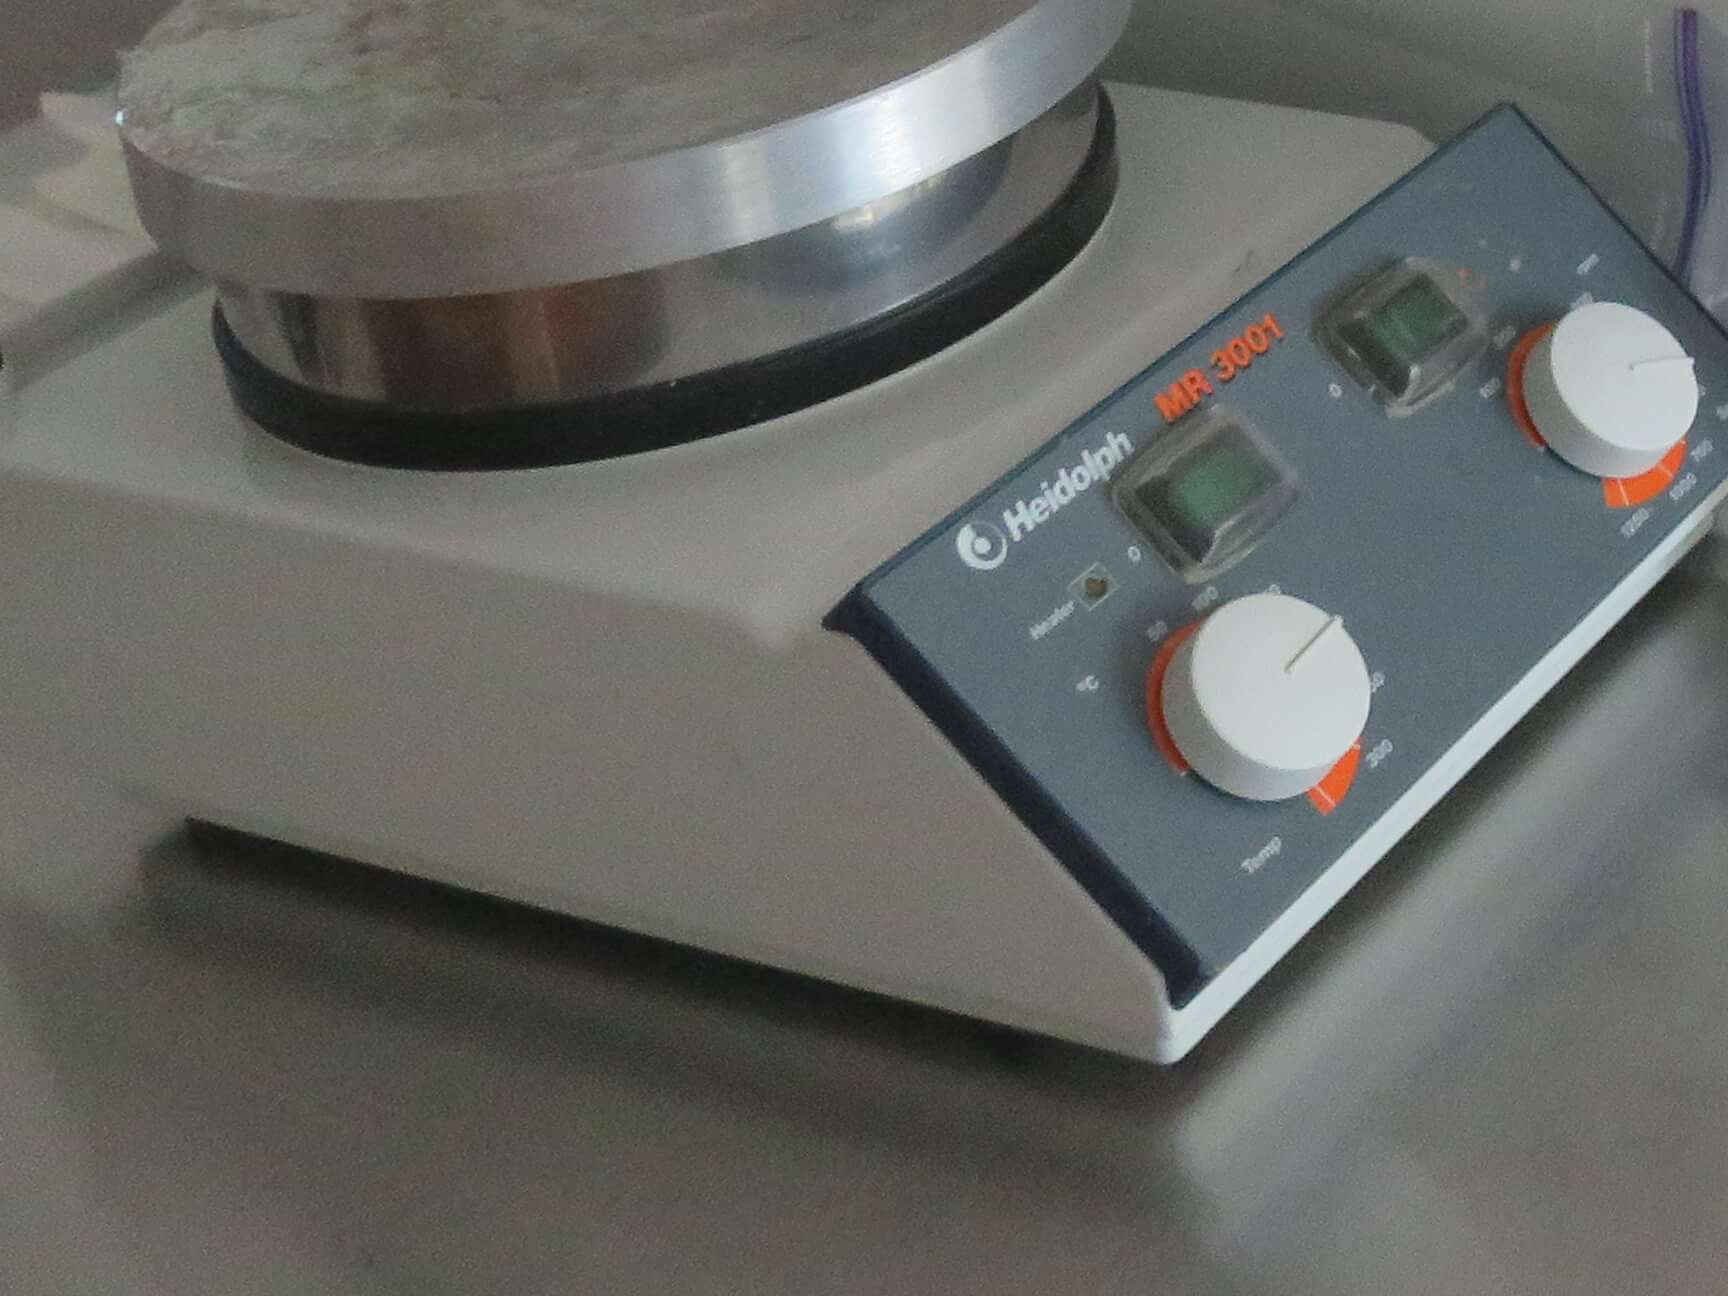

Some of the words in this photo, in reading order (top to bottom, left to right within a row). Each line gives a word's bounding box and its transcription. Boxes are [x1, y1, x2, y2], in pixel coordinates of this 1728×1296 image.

[1153, 368, 1214, 423] MR
[1208, 312, 1285, 383] 3001
[1001, 429, 1136, 542] Heidolph
[1239, 835, 1284, 875] Temp
